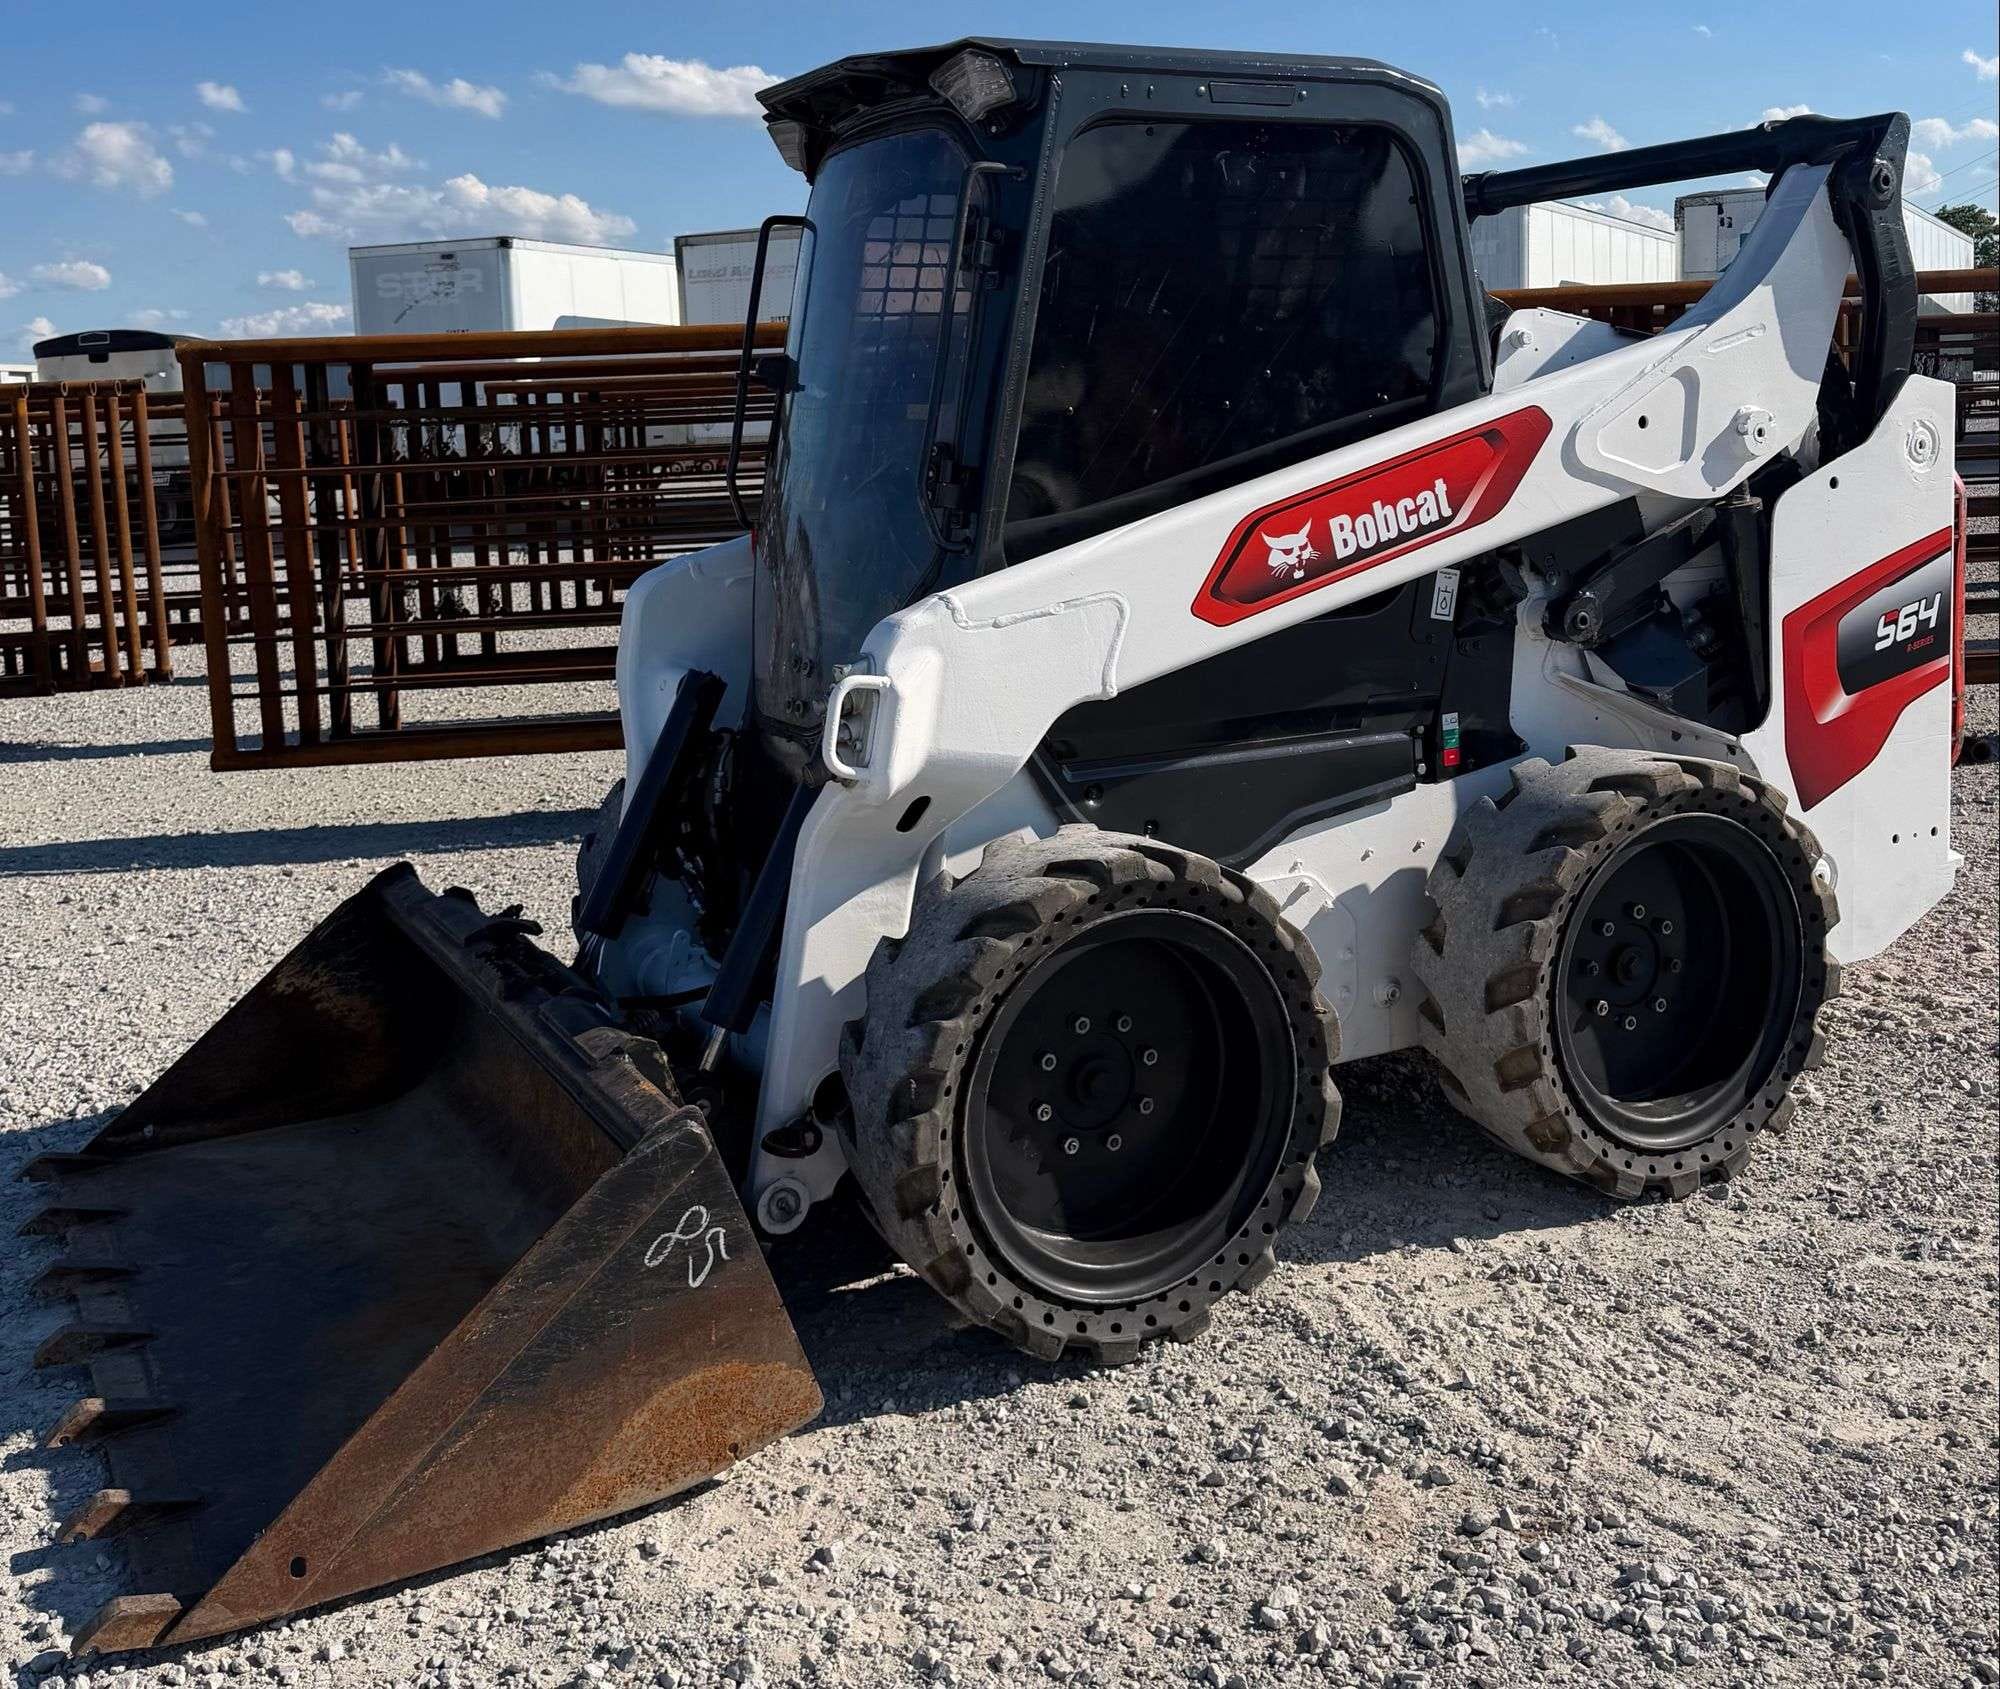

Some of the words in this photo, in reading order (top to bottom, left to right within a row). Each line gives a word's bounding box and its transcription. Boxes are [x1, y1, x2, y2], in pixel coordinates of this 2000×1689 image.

[1329, 479, 1453, 560] Bobcat
[1874, 592, 1942, 652] S64
[643, 1205, 731, 1289] 85
